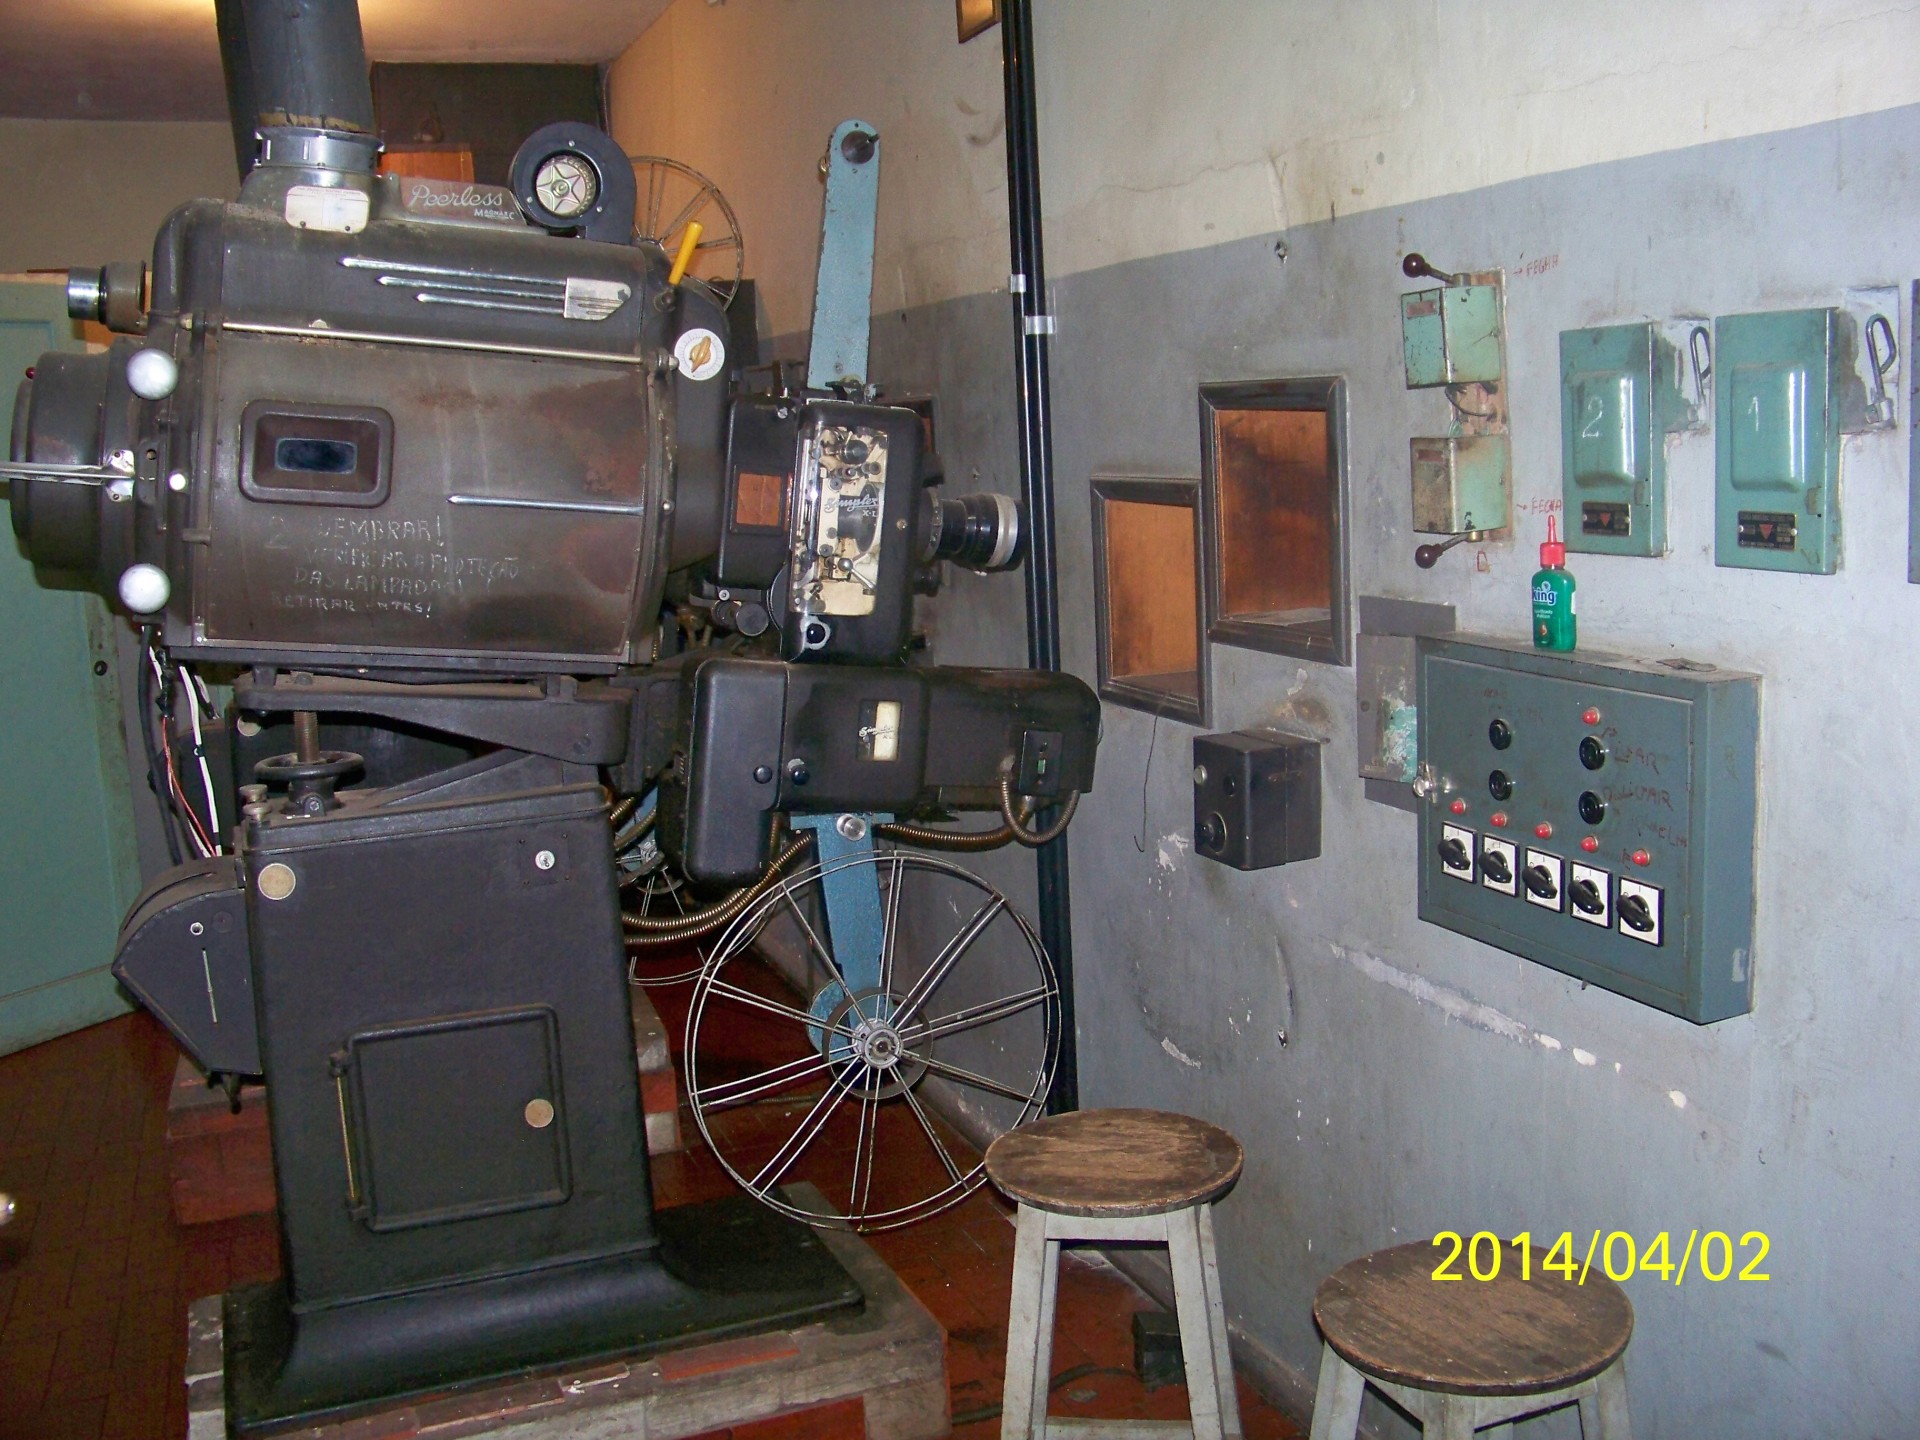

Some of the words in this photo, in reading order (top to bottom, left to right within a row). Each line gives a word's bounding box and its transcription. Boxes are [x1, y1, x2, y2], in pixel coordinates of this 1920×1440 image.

[407, 185, 503, 208] Peerless
[1582, 396, 1603, 438] 2
[1747, 396, 1760, 432] 1
